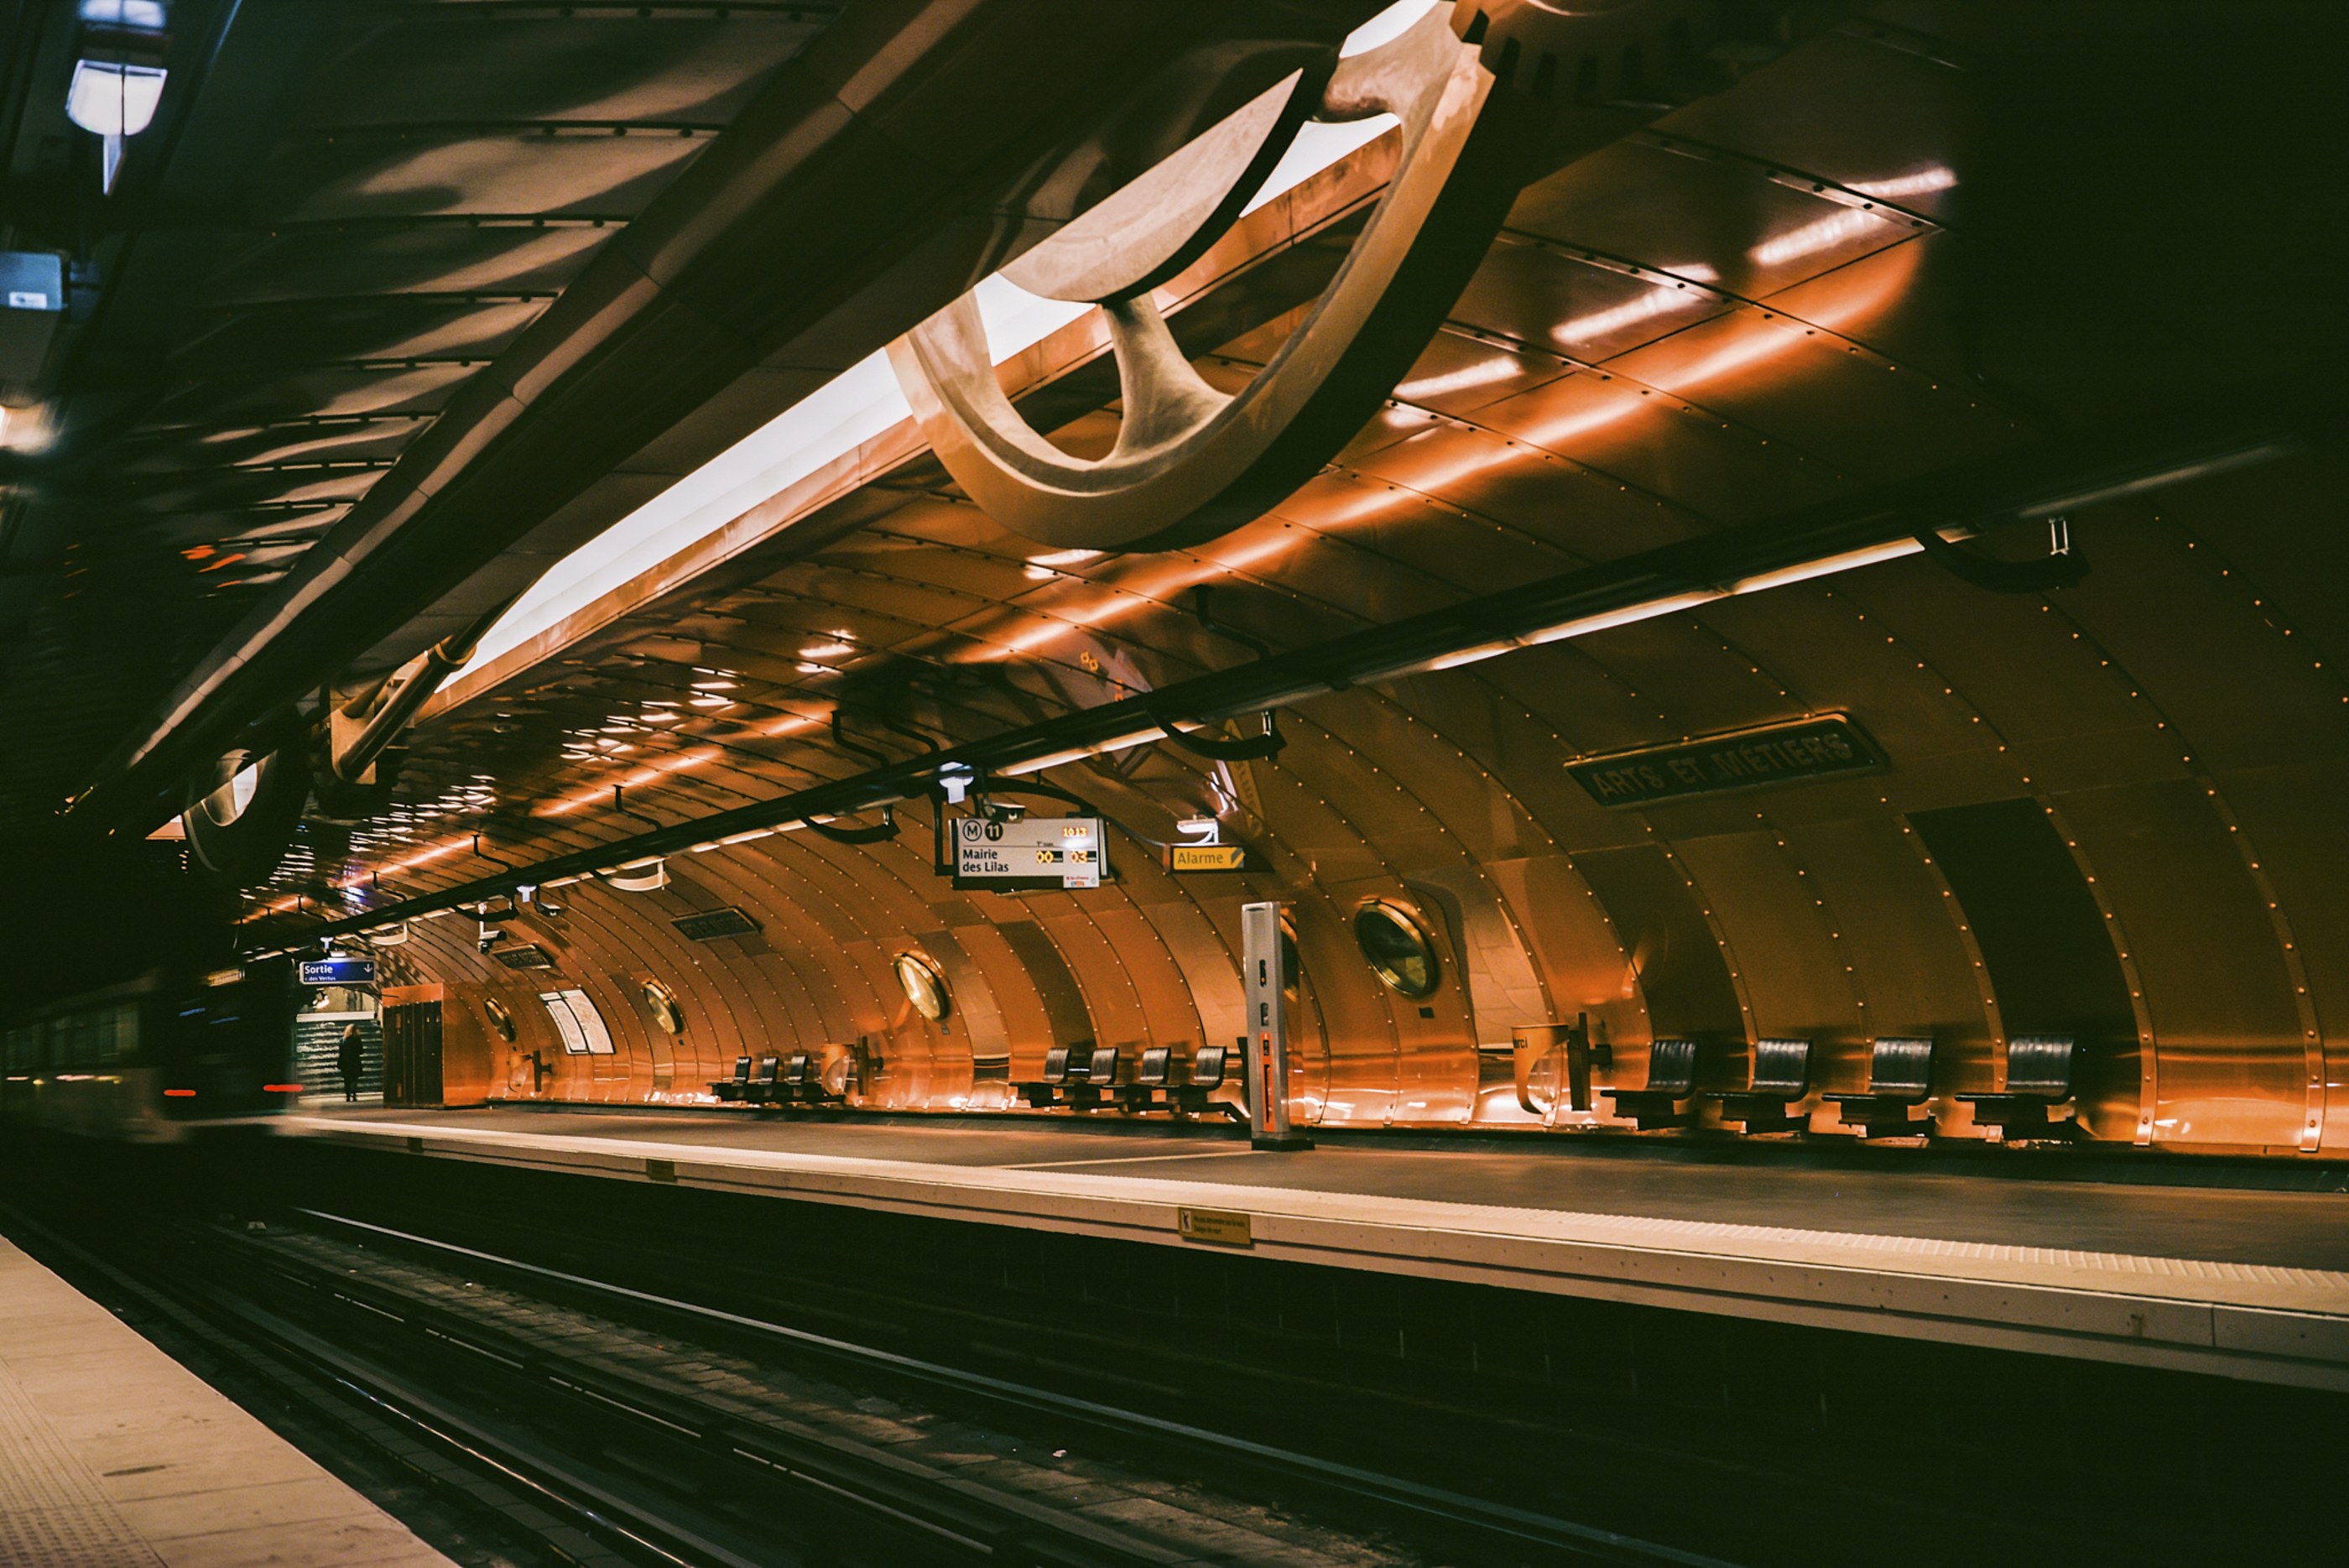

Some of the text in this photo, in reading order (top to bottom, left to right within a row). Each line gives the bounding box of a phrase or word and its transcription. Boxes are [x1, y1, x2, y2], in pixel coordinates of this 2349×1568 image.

[1591, 732, 1853, 799] ARTS ET MÉTIERS
[987, 825, 1000, 838] 11
[962, 849, 997, 860] Mairie
[1035, 850, 1054, 864] 00
[1070, 850, 1088, 864] 03
[1177, 852, 1224, 865] Alarme
[962, 861, 1009, 873] des Lilas
[305, 965, 333, 974] Sortie
